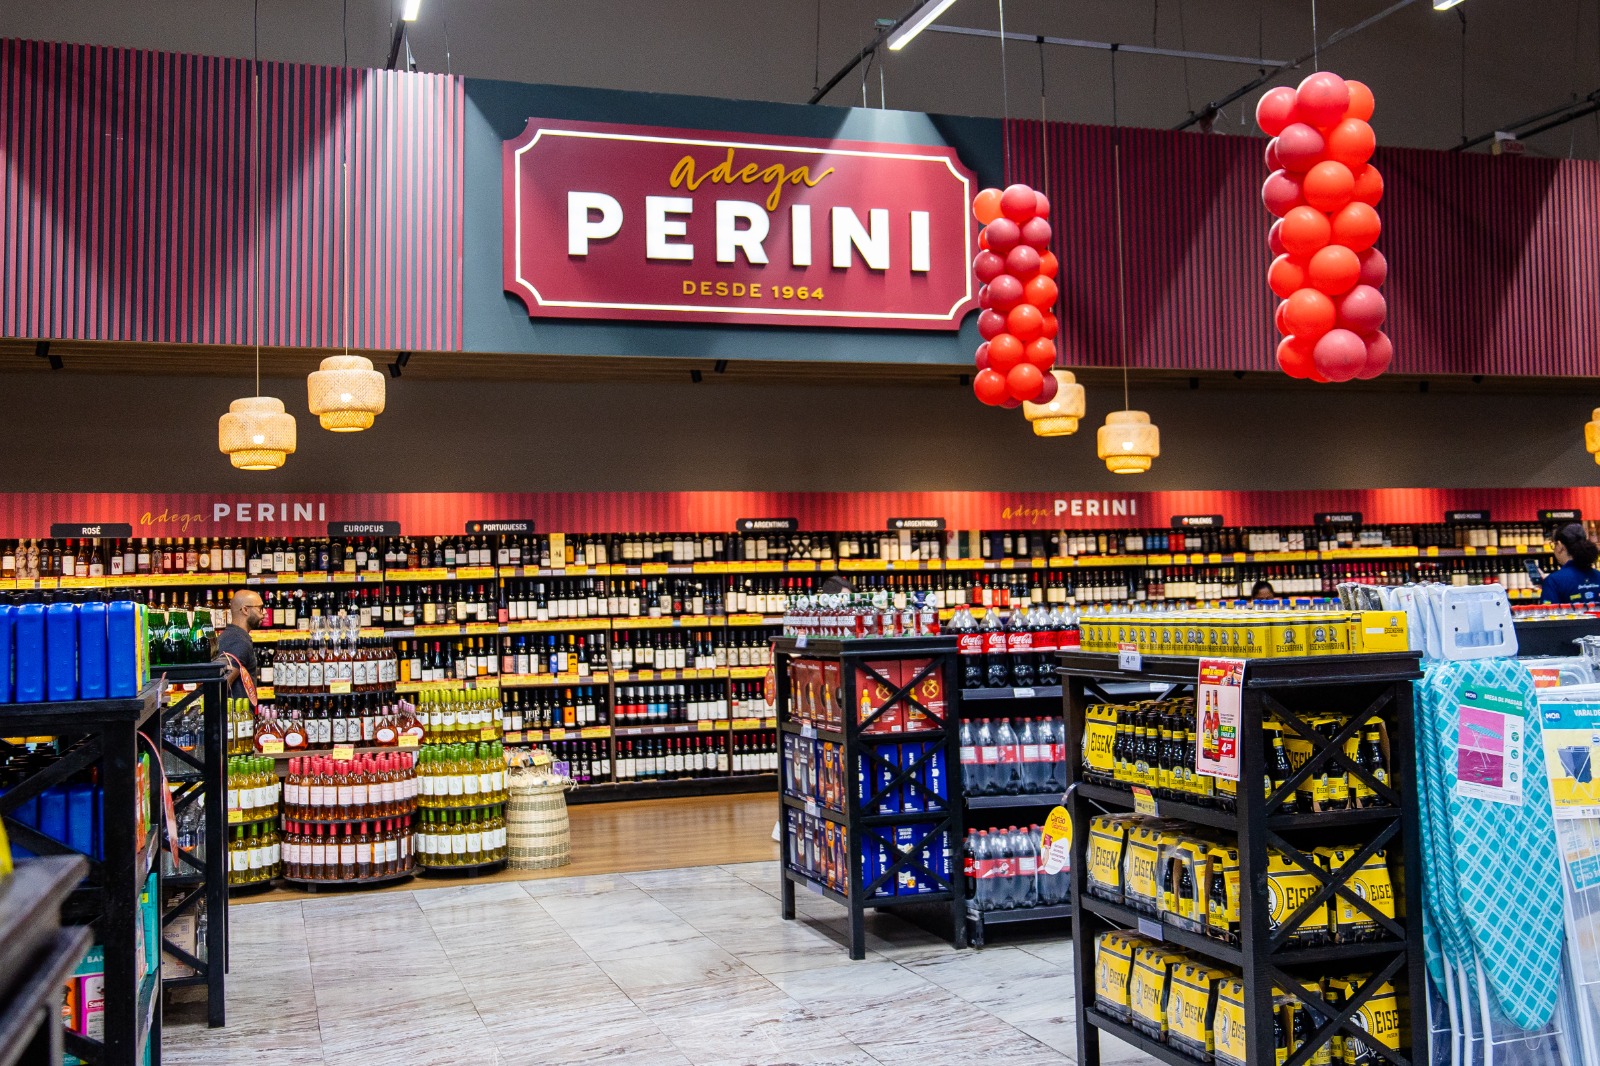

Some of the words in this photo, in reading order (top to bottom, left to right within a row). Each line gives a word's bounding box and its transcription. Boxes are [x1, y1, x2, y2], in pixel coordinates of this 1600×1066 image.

[669, 148, 835, 211] adega
[566, 189, 931, 273] PERINI
[682, 279, 763, 299] DESDE
[771, 285, 824, 300] 1964
[140, 508, 212, 532] adega
[213, 502, 326, 522] PERINI
[1001, 505, 1053, 524] adega
[1054, 499, 1136, 516] PERINI
[82, 526, 101, 535] ROSÉ
[344, 524, 384, 533] EUROPEUS
[483, 523, 527, 531] PORTUGUESES
[753, 520, 789, 529] ARGENTINOS
[903, 519, 938, 528] ARGENTINOS
[1573, 709, 1592, 717] VARAL
[1091, 732, 1112, 754] EISEN
[1095, 846, 1119, 871] EISEN
[1109, 968, 1126, 988] EISEN
[1143, 984, 1161, 1005] EISEN
[1184, 1001, 1205, 1023] EISEN
[1375, 1009, 1399, 1034] EISE
[1231, 1020, 1245, 1041] EISE
